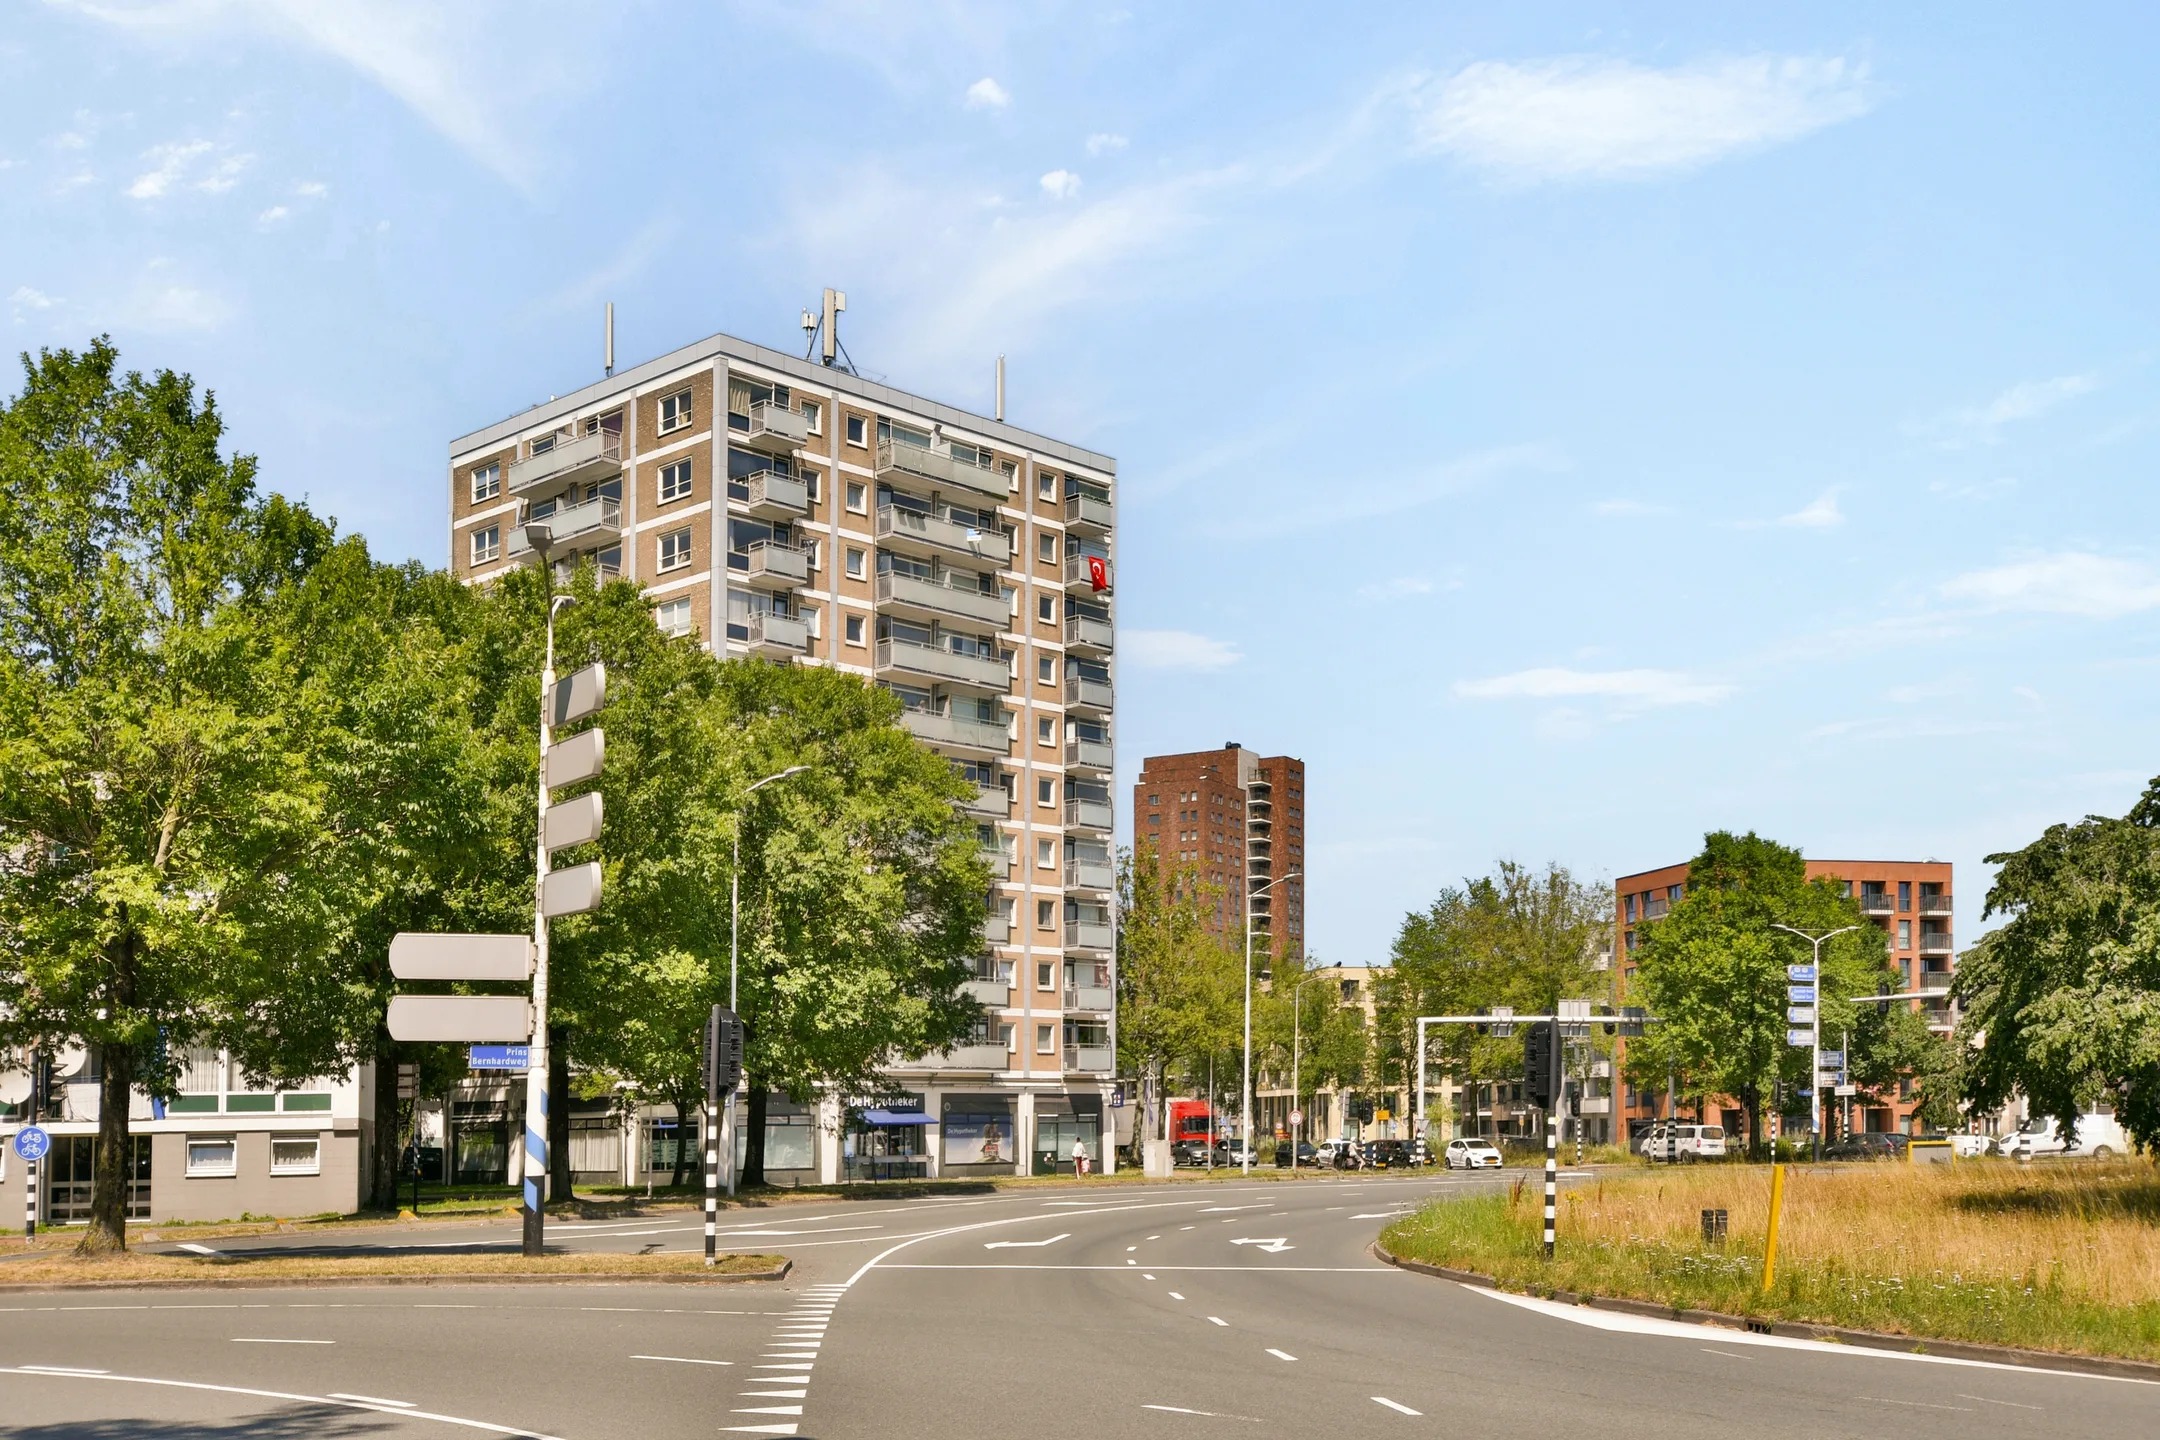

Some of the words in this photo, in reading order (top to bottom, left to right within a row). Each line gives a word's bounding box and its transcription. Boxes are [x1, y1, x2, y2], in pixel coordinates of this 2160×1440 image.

[506, 1048, 527, 1056] Prins
[472, 1057, 527, 1067] Bernhardweg
[850, 1095, 863, 1107] De
